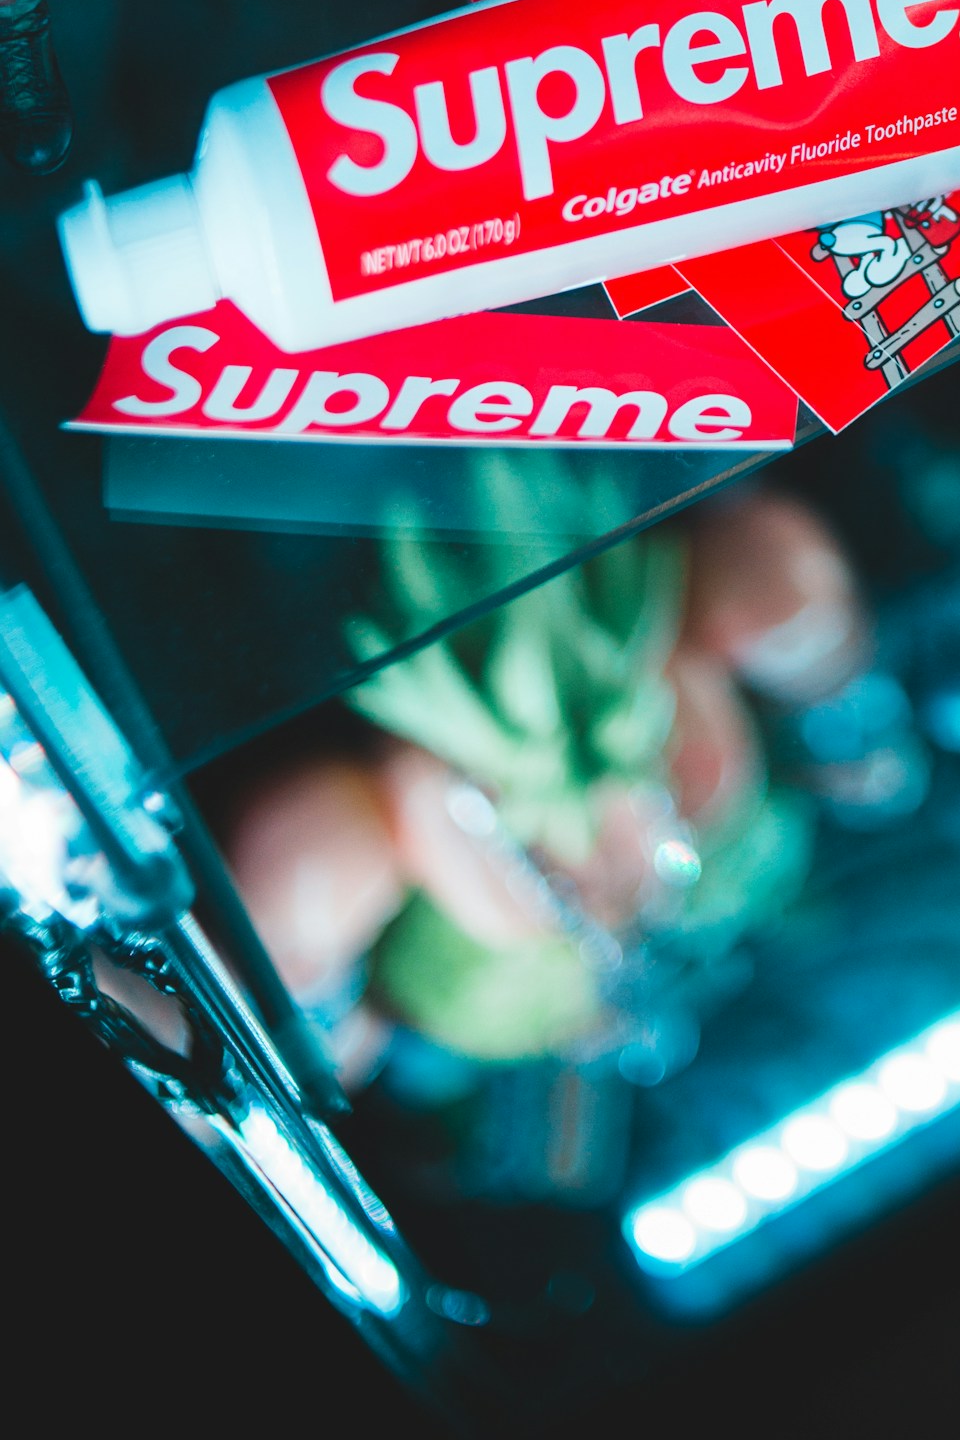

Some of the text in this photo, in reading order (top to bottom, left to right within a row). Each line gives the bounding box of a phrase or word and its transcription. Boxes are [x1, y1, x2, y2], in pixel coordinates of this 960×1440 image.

[696, 150, 787, 189] Anticavity
[790, 131, 861, 163] Fluoride
[864, 106, 958, 143] Toothpaste
[360, 246, 396, 277] NET
[111, 324, 753, 441] Supreme
